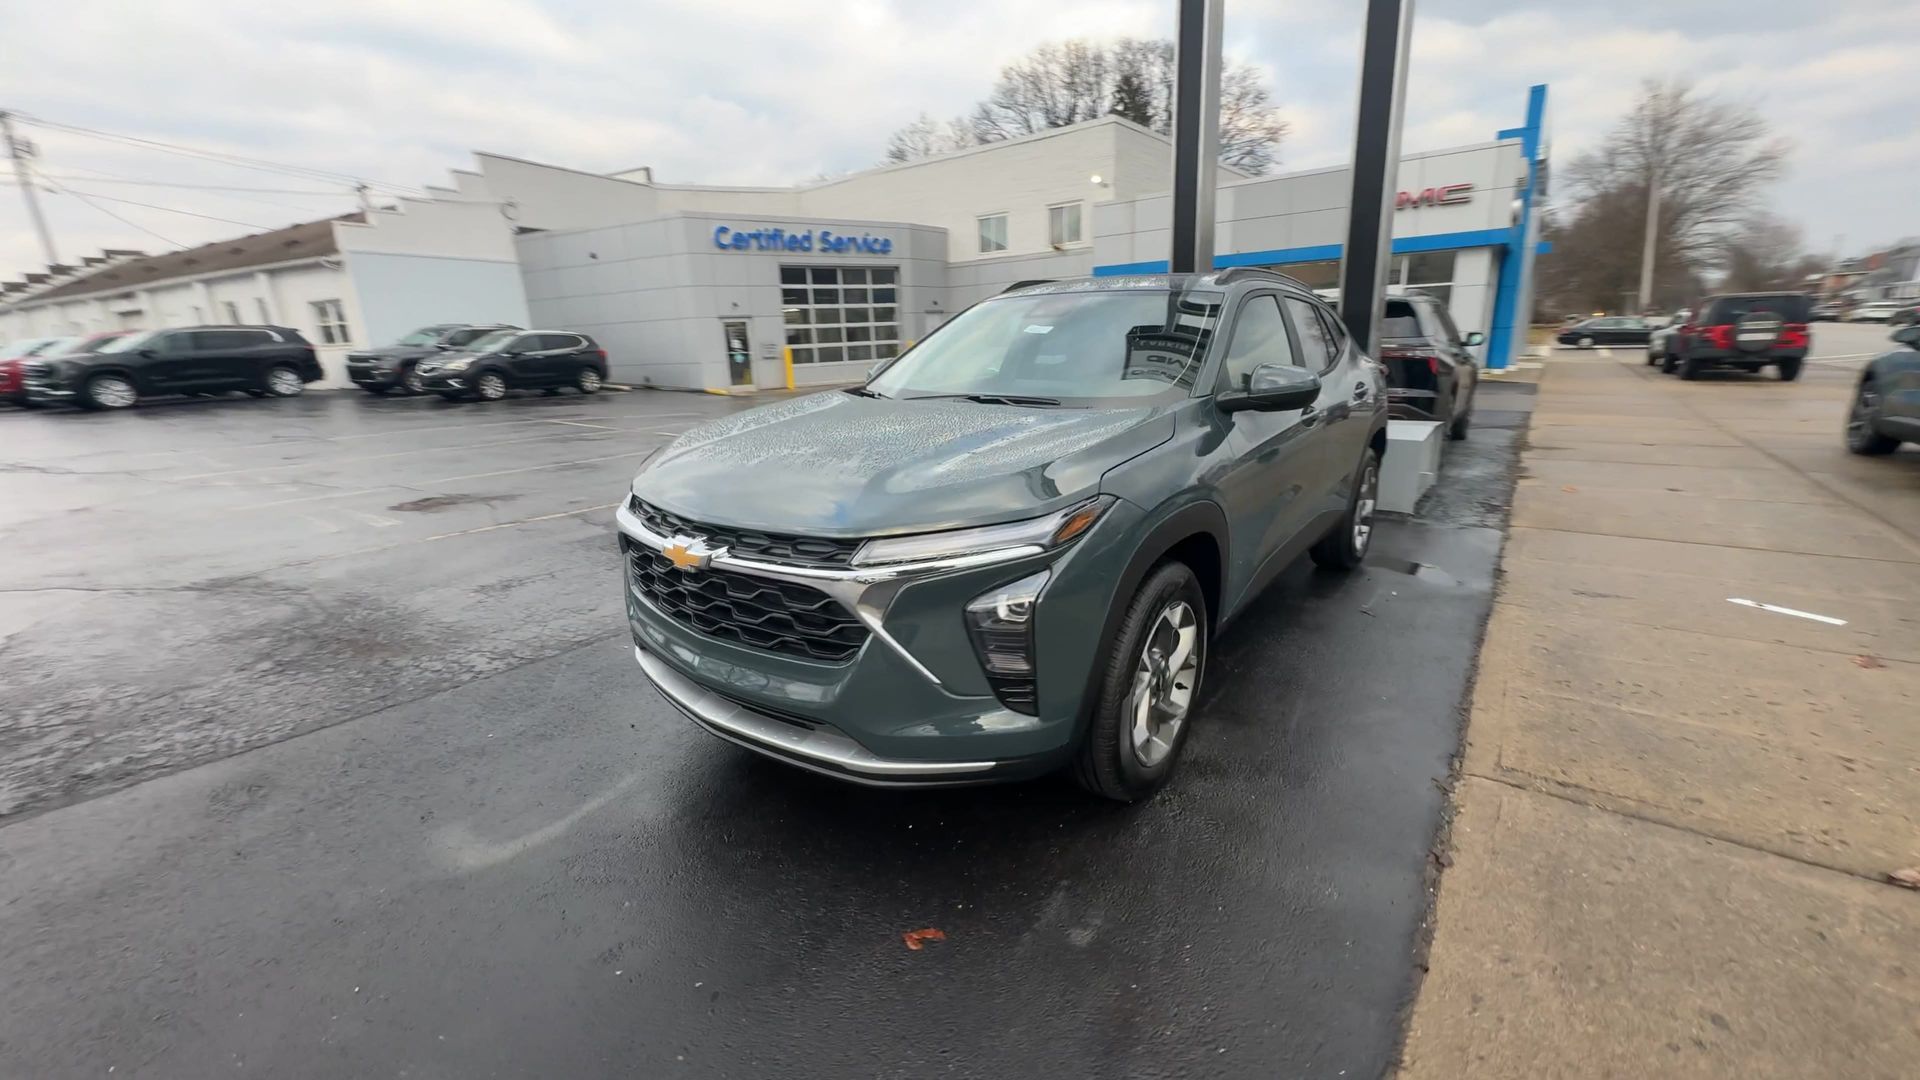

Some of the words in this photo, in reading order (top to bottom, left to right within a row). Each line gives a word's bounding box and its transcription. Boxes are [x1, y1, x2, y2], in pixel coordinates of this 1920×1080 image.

[1394, 182, 1474, 209] MC
[714, 225, 813, 252] Certified
[819, 230, 892, 255] Service
